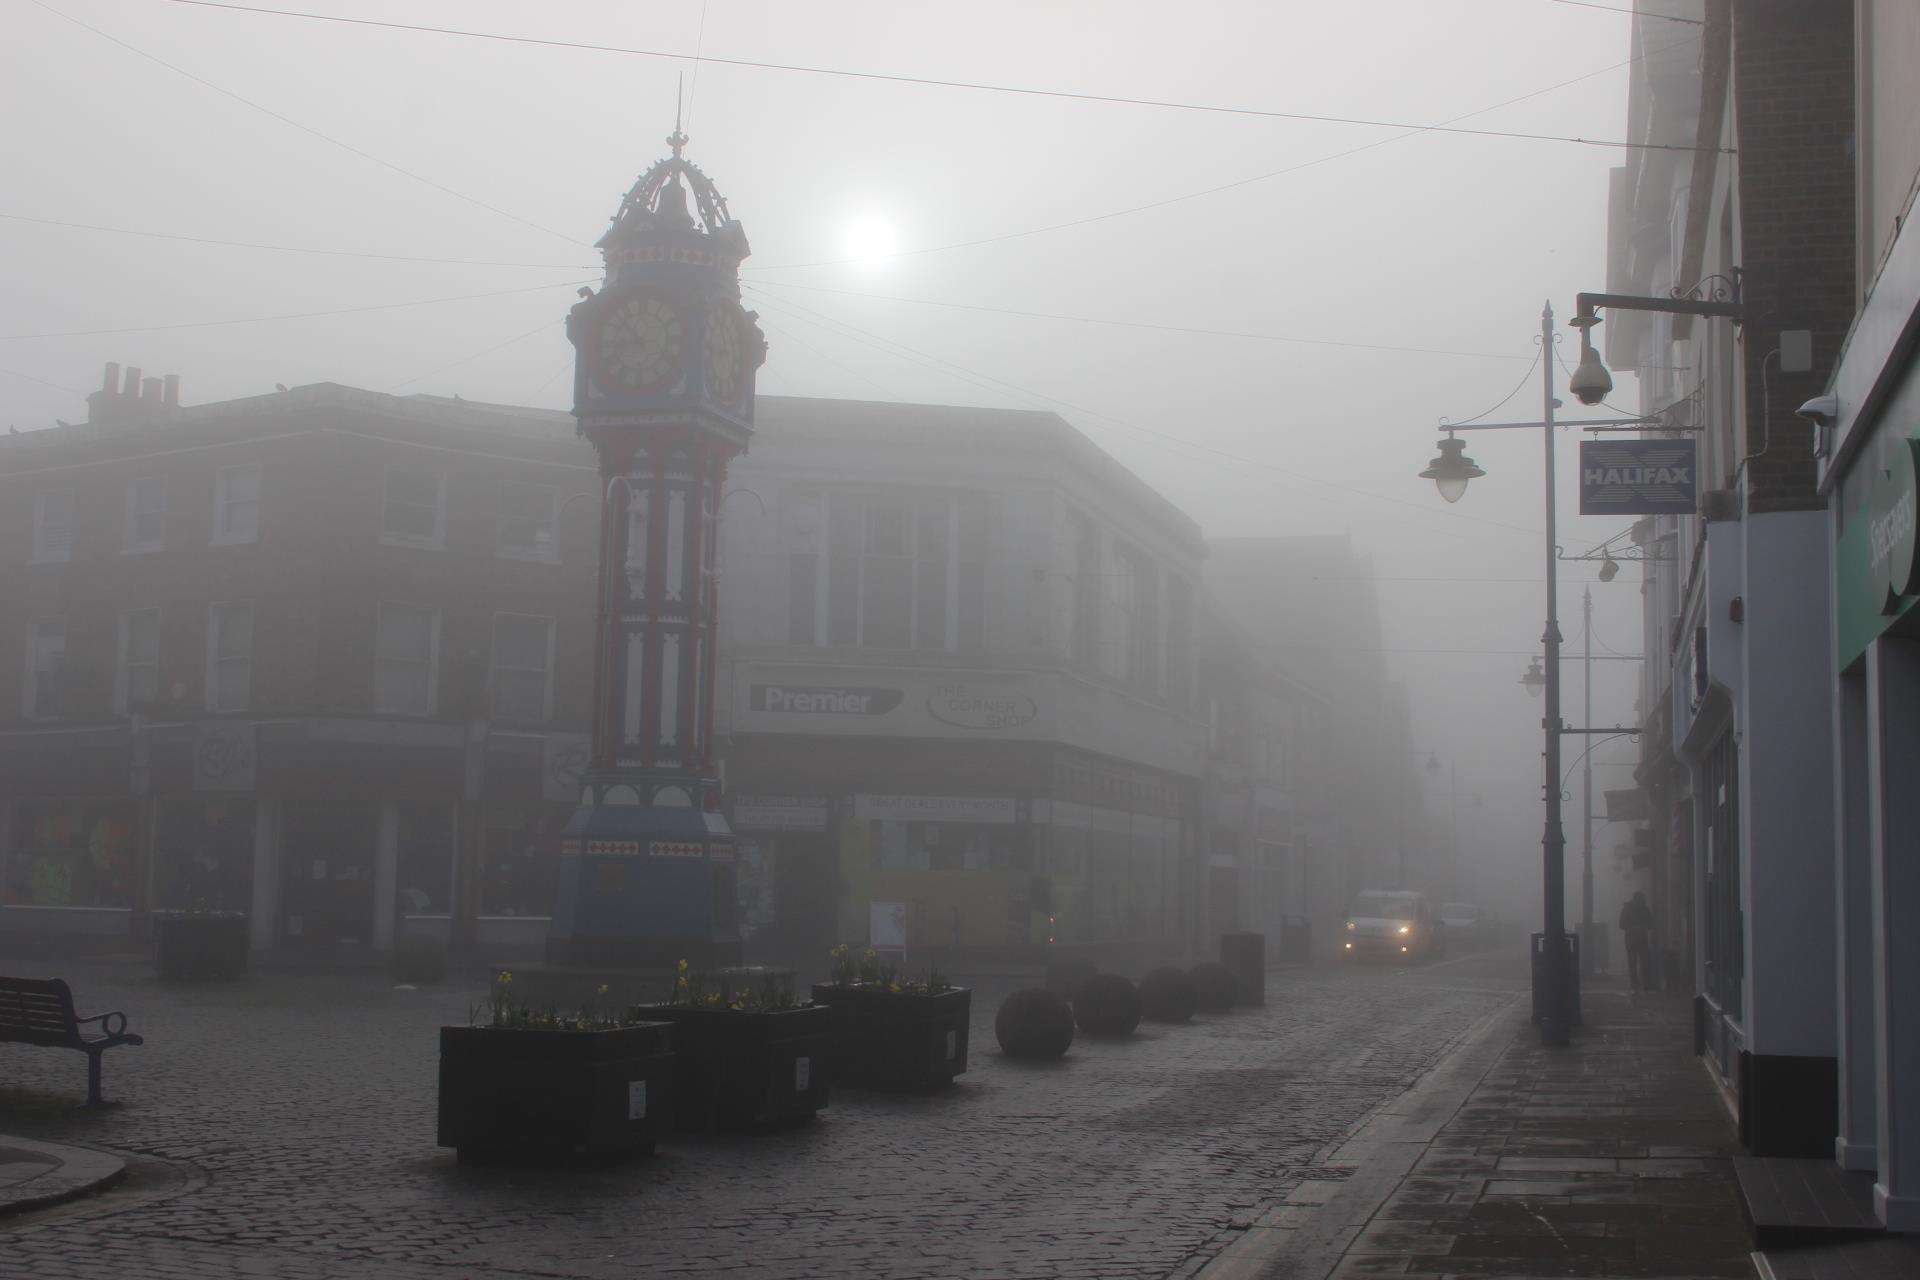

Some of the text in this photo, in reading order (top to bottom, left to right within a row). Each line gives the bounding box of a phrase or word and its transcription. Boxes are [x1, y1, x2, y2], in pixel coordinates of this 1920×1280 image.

[1584, 467, 1691, 485] HALIFAX
[936, 684, 969, 697] THE
[765, 687, 871, 712] Premier
[948, 699, 1016, 713] CORNER
[985, 714, 1031, 728] SHOP
